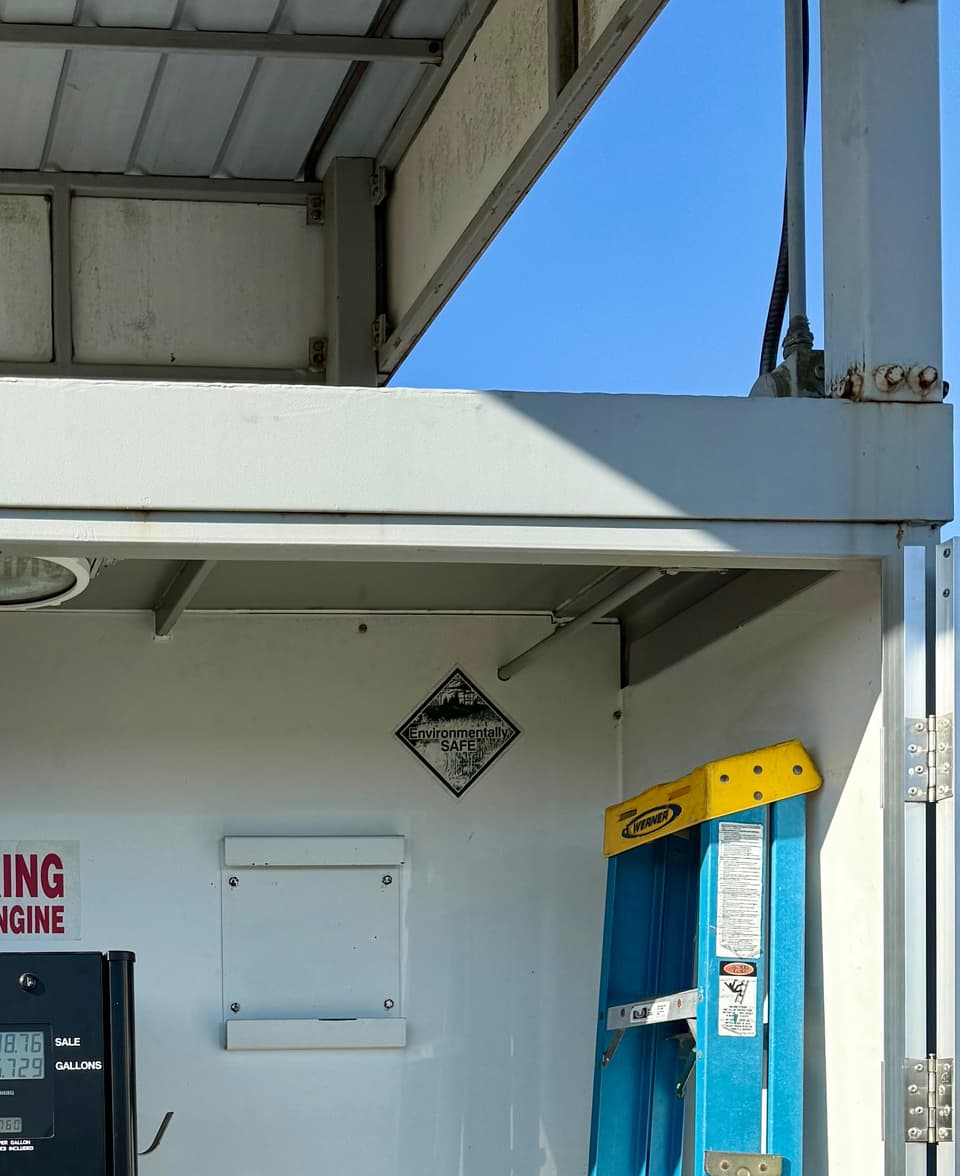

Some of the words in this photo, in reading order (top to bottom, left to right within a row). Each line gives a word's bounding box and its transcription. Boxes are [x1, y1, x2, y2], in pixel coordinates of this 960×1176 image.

[409, 727, 507, 739] Environmentally
[441, 740, 476, 751] SAFE
[632, 809, 669, 834] WERNER
[55, 1037, 81, 1047] SALE
[55, 1060, 103, 1071] GALLONS
